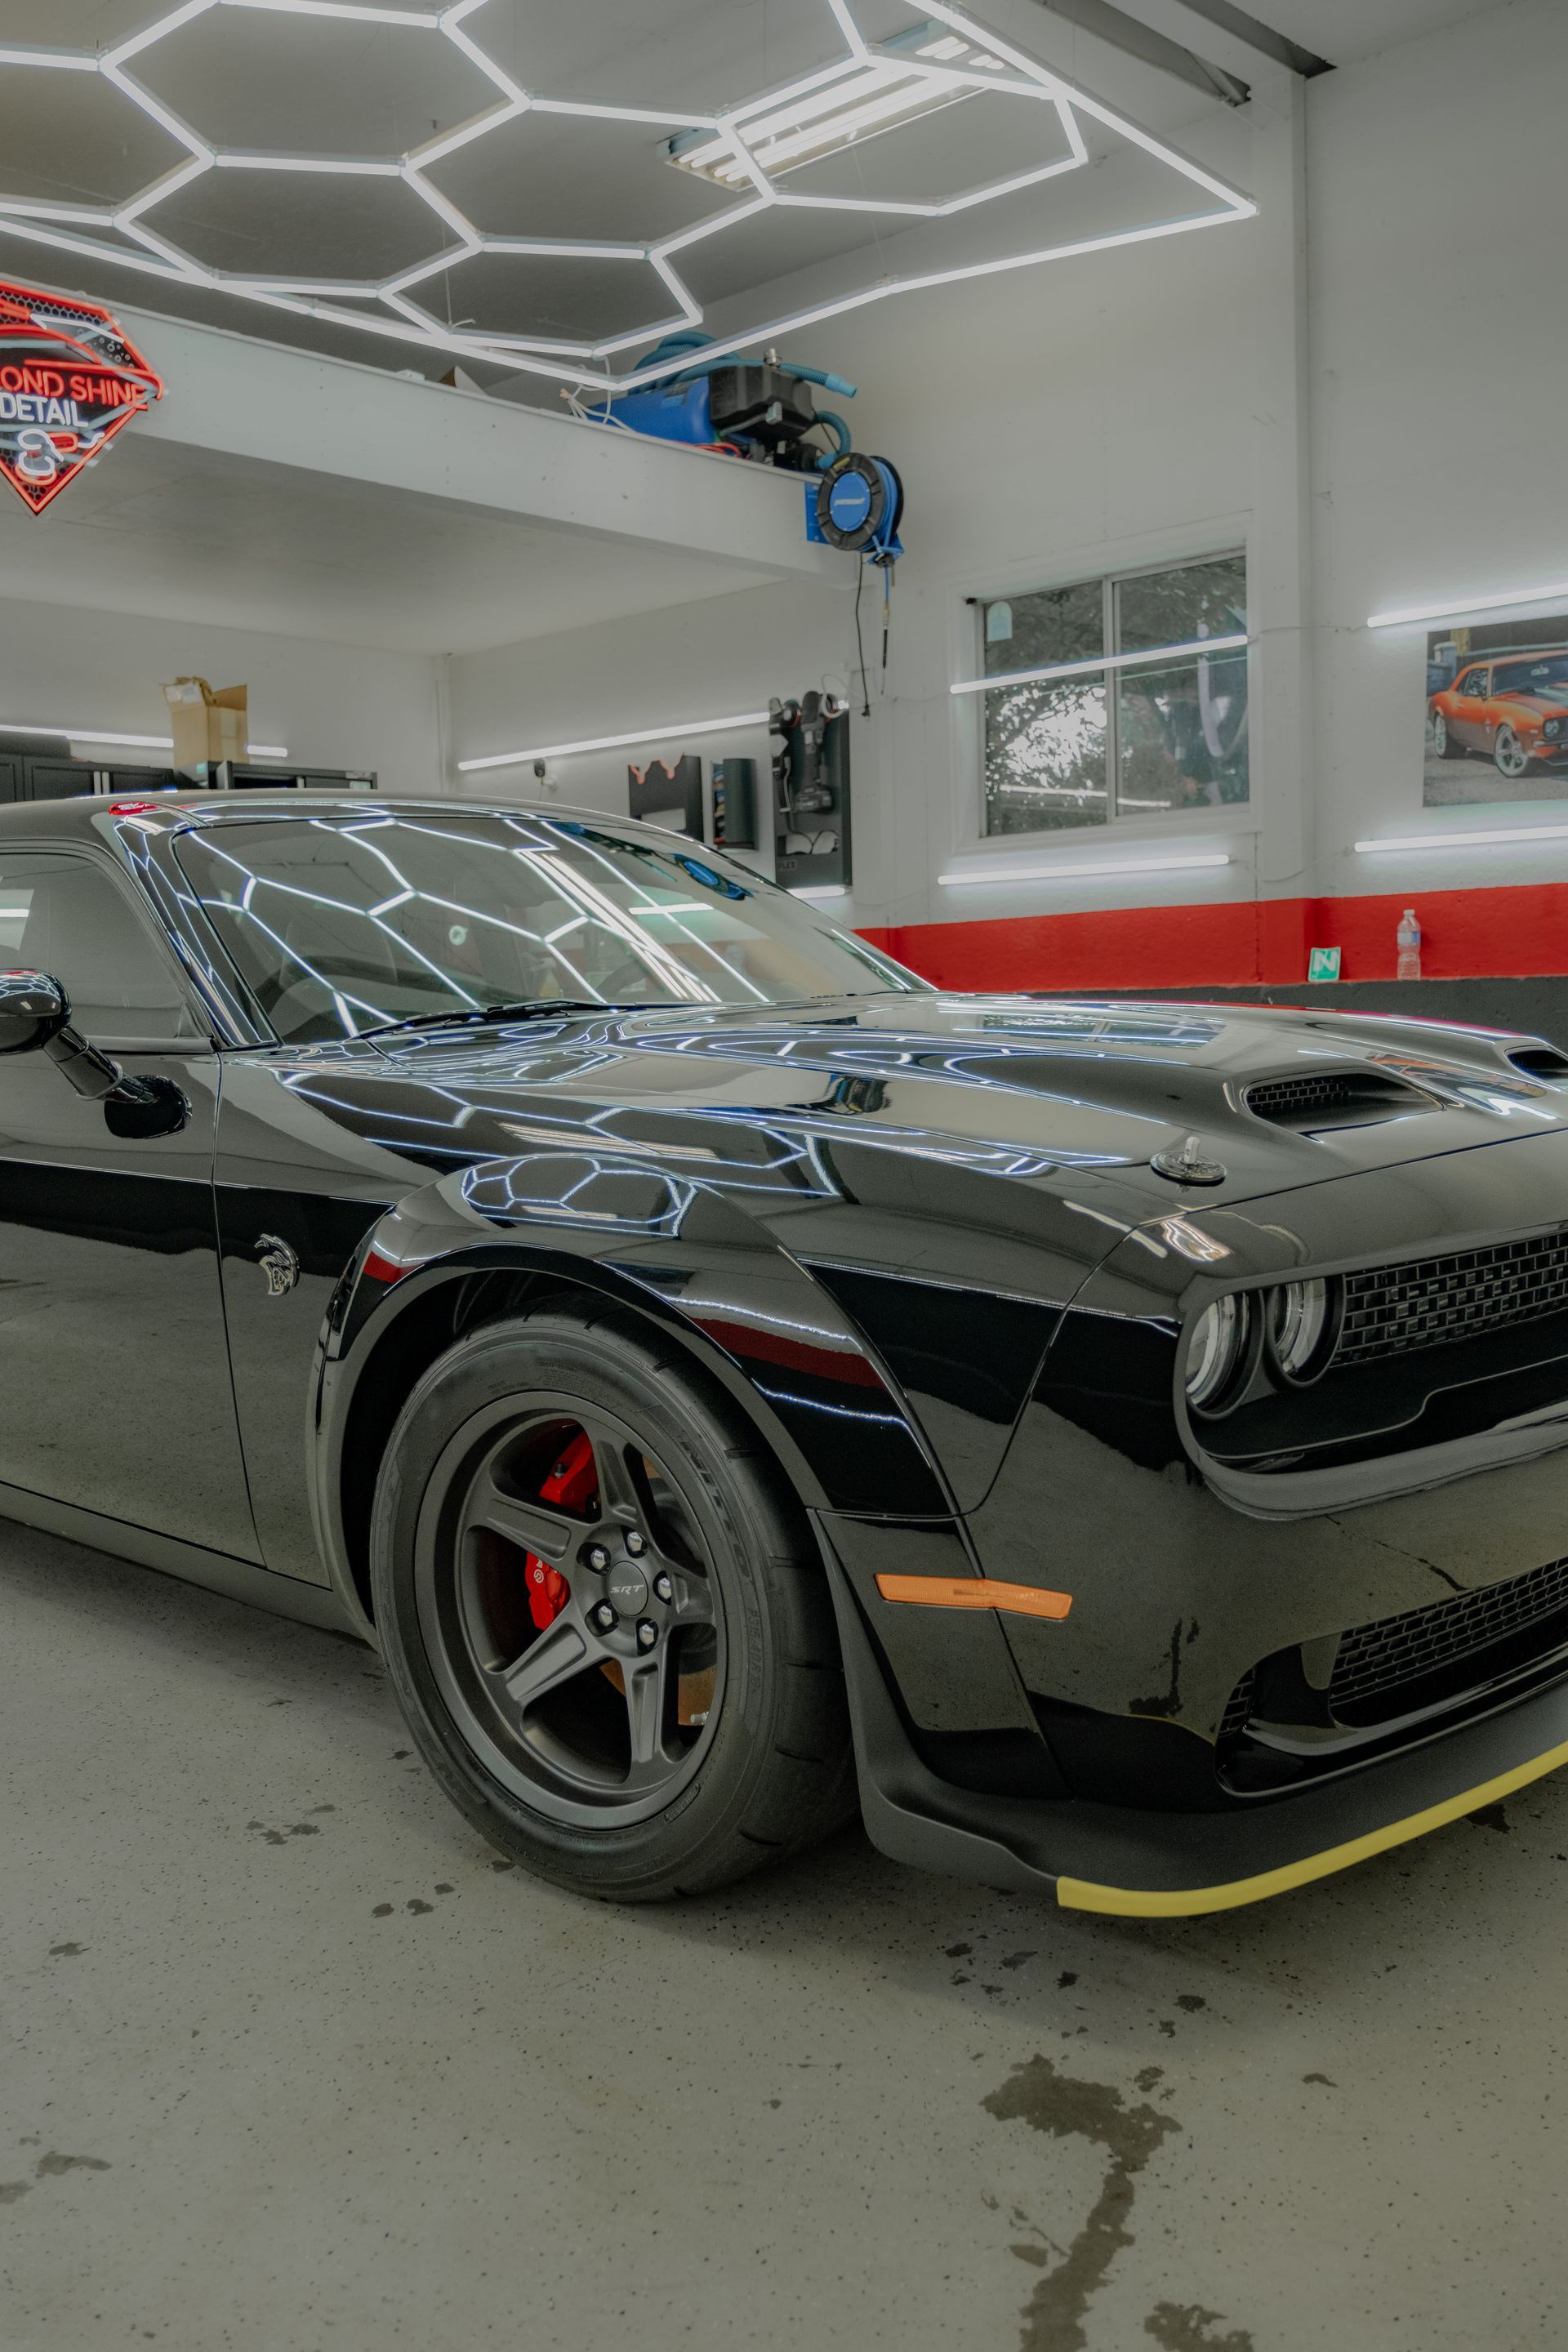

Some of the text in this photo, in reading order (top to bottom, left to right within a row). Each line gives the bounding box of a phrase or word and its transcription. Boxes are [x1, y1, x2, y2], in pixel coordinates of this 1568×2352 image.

[0, 393, 88, 427] DETAIL
[70, 375, 149, 411] SHINE
[609, 1584, 644, 1595] SRT
